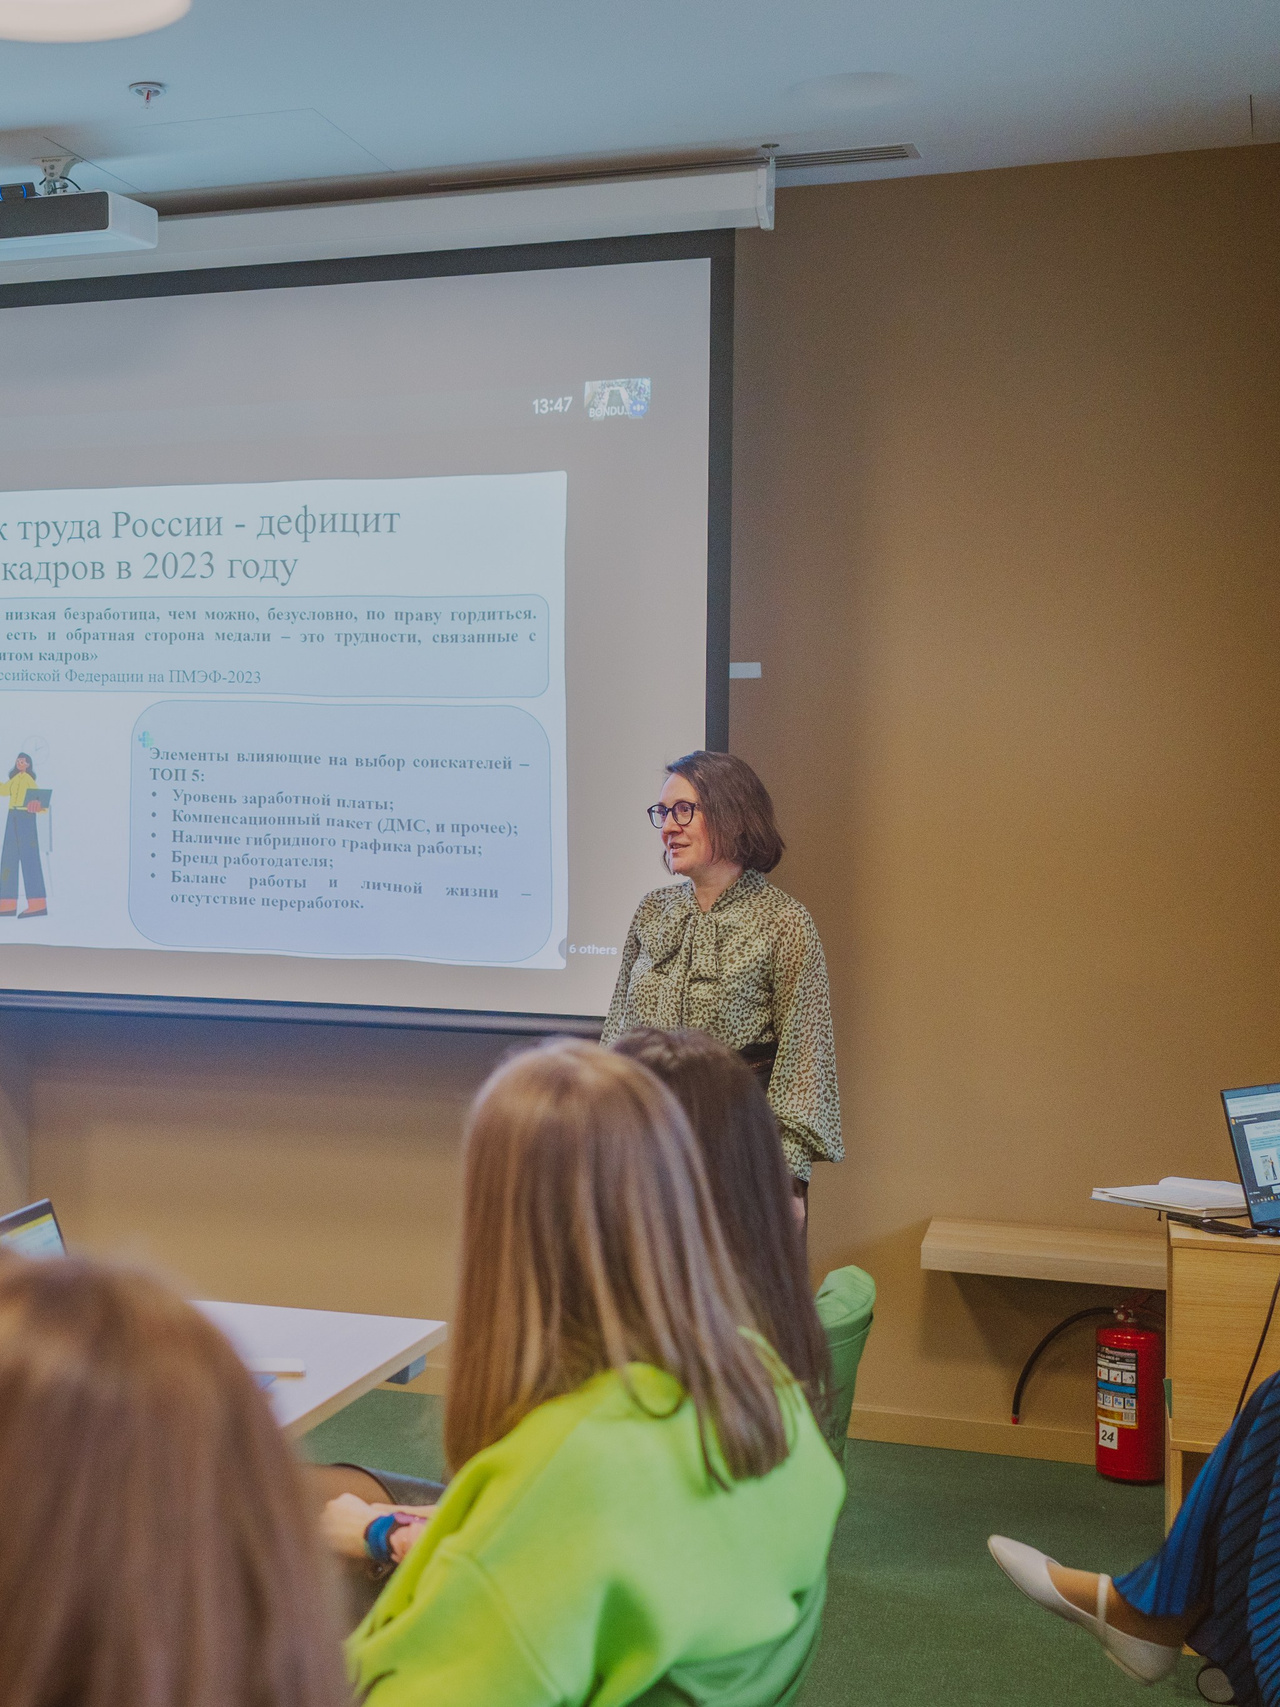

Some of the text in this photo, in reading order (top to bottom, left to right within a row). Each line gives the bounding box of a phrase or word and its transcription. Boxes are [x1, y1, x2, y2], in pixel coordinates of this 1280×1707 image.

[533, 396, 573, 414] 13:47
[18, 520, 101, 547] труда
[112, 511, 222, 538] России
[257, 505, 401, 542] дефицит
[1, 551, 298, 588] кадров в 2023 году
[5, 610, 56, 621] низкая
[64, 607, 160, 624] безработица,
[168, 610, 196, 620] чем
[205, 610, 259, 622] можно,
[268, 607, 358, 624] безусловно,
[366, 610, 385, 621] по
[395, 610, 441, 625] праву
[451, 609, 537, 625] гордиться.
[6, 631, 37, 641] есть
[47, 631, 56, 641] и
[66, 628, 134, 644] обратная
[145, 631, 204, 645] сторона
[215, 631, 271, 643] медали
[300, 632, 324, 642] это
[335, 631, 421, 646] трудности,
[432, 631, 518, 643] связанные
[529, 632, 536, 642] с
[39, 651, 98, 665] кадров»
[65, 669, 143, 686] Федерации
[148, 672, 164, 683] на
[169, 670, 261, 684] ПМЭФ-2023
[150, 747, 229, 762] Элементы
[237, 752, 321, 766] влияющие
[329, 756, 348, 766] на
[355, 754, 405, 771] выбор
[413, 756, 512, 770] соискателей
[150, 767, 205, 783] ТОП 5:
[172, 789, 394, 812] Уровень заработной платы;
[172, 809, 518, 837] Компенсационный пакет (ДМС, и прочее);
[172, 830, 482, 857] Наличие гибридного графика работы;
[172, 851, 333, 870] Бренд работодателя;
[172, 870, 227, 886] Баланс
[249, 874, 307, 890] работы
[329, 878, 338, 888] и
[361, 880, 423, 895] личной
[446, 886, 499, 899] жизни
[171, 893, 364, 912] отсутствие переработок.
[569, 944, 617, 955] 6 others
[1101, 1430, 1114, 1442] 24
